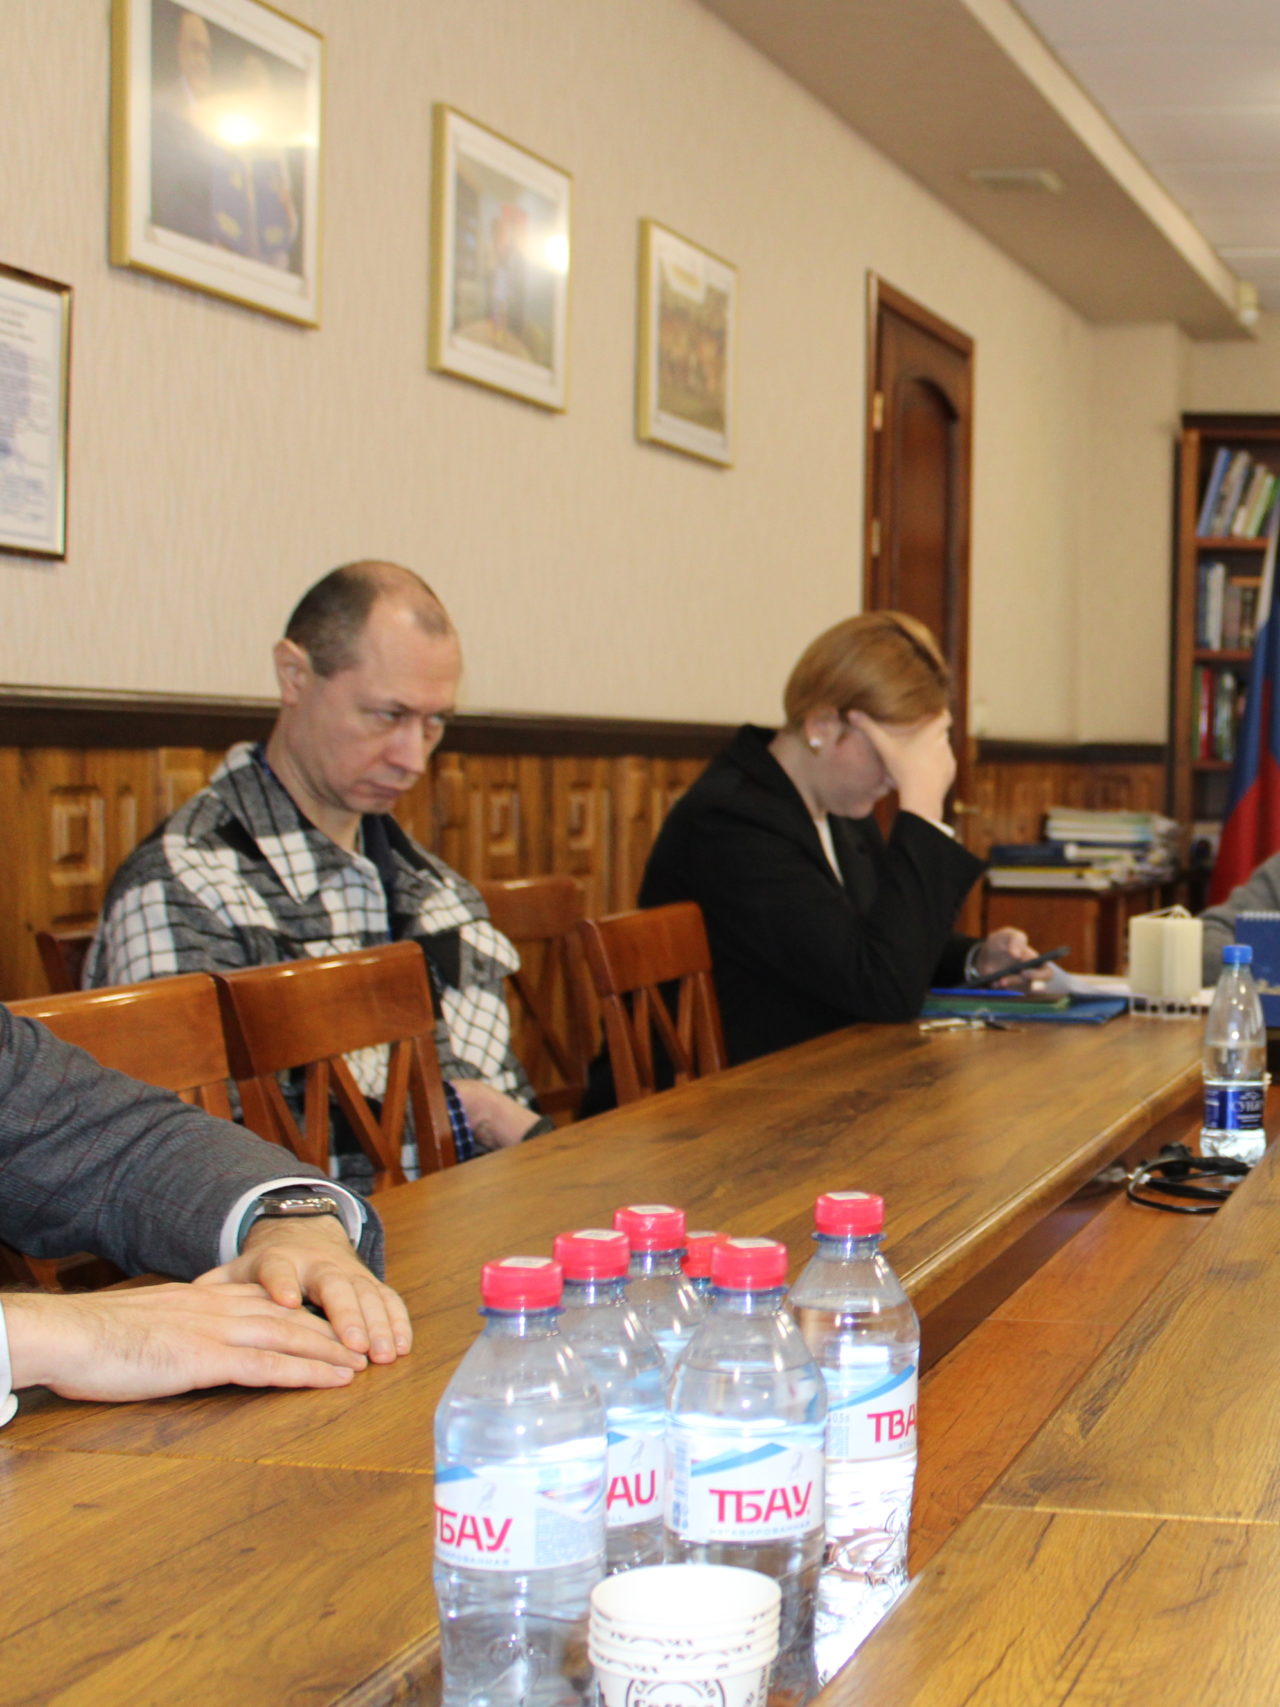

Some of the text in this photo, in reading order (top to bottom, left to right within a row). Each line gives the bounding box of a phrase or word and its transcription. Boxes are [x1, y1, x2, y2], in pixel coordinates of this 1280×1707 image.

[867, 1403, 915, 1443] TBA
[606, 1469, 655, 1511] AU
[709, 1480, 812, 1523] ТБАУ
